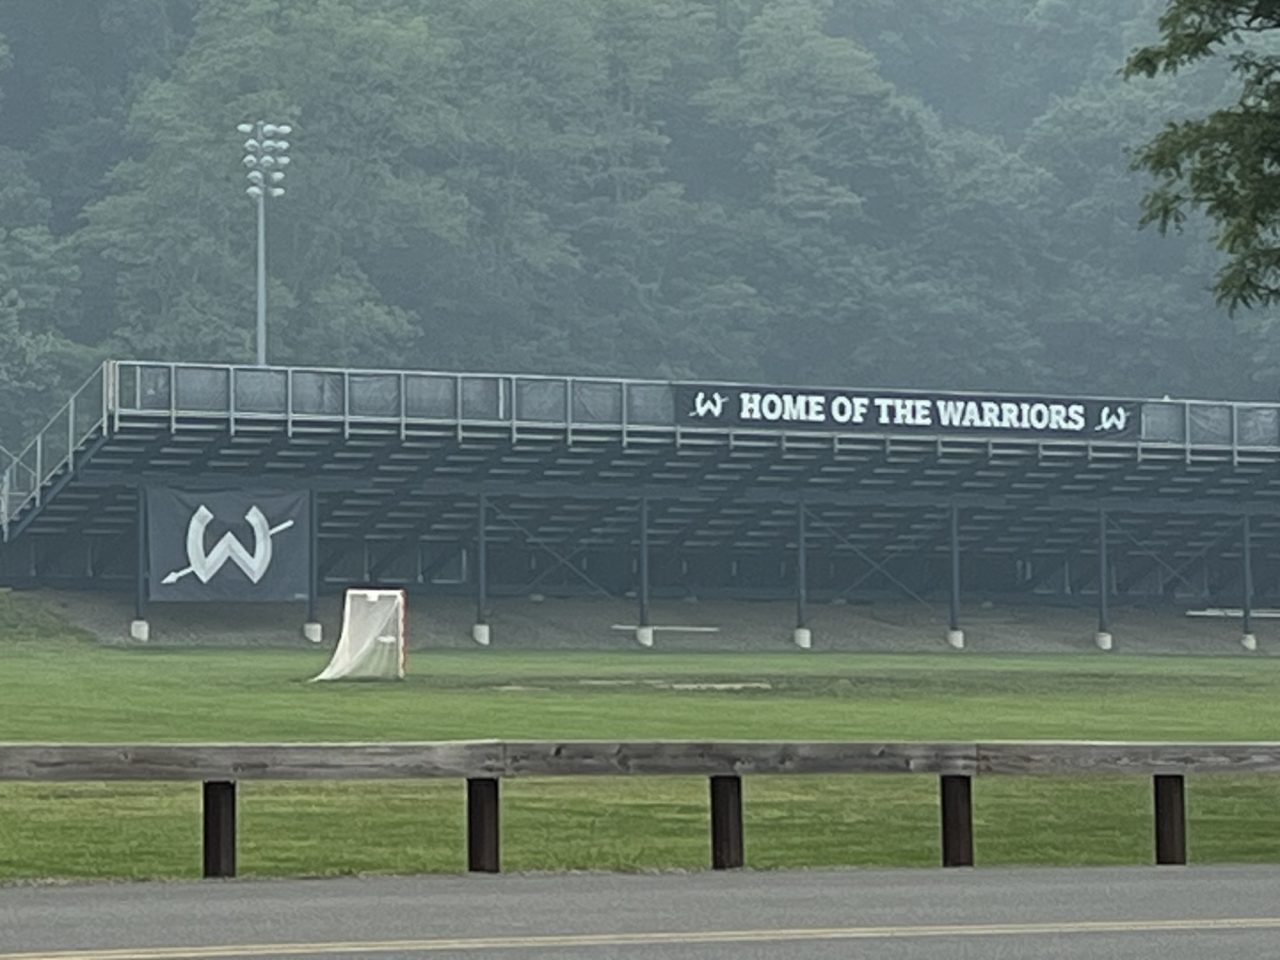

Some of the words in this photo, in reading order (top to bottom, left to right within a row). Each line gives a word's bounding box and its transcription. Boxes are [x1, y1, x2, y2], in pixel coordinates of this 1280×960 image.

[740, 393, 826, 422] HOME
[831, 396, 869, 423] OF
[874, 398, 932, 426] THE
[936, 400, 1086, 431] WARRIORS
